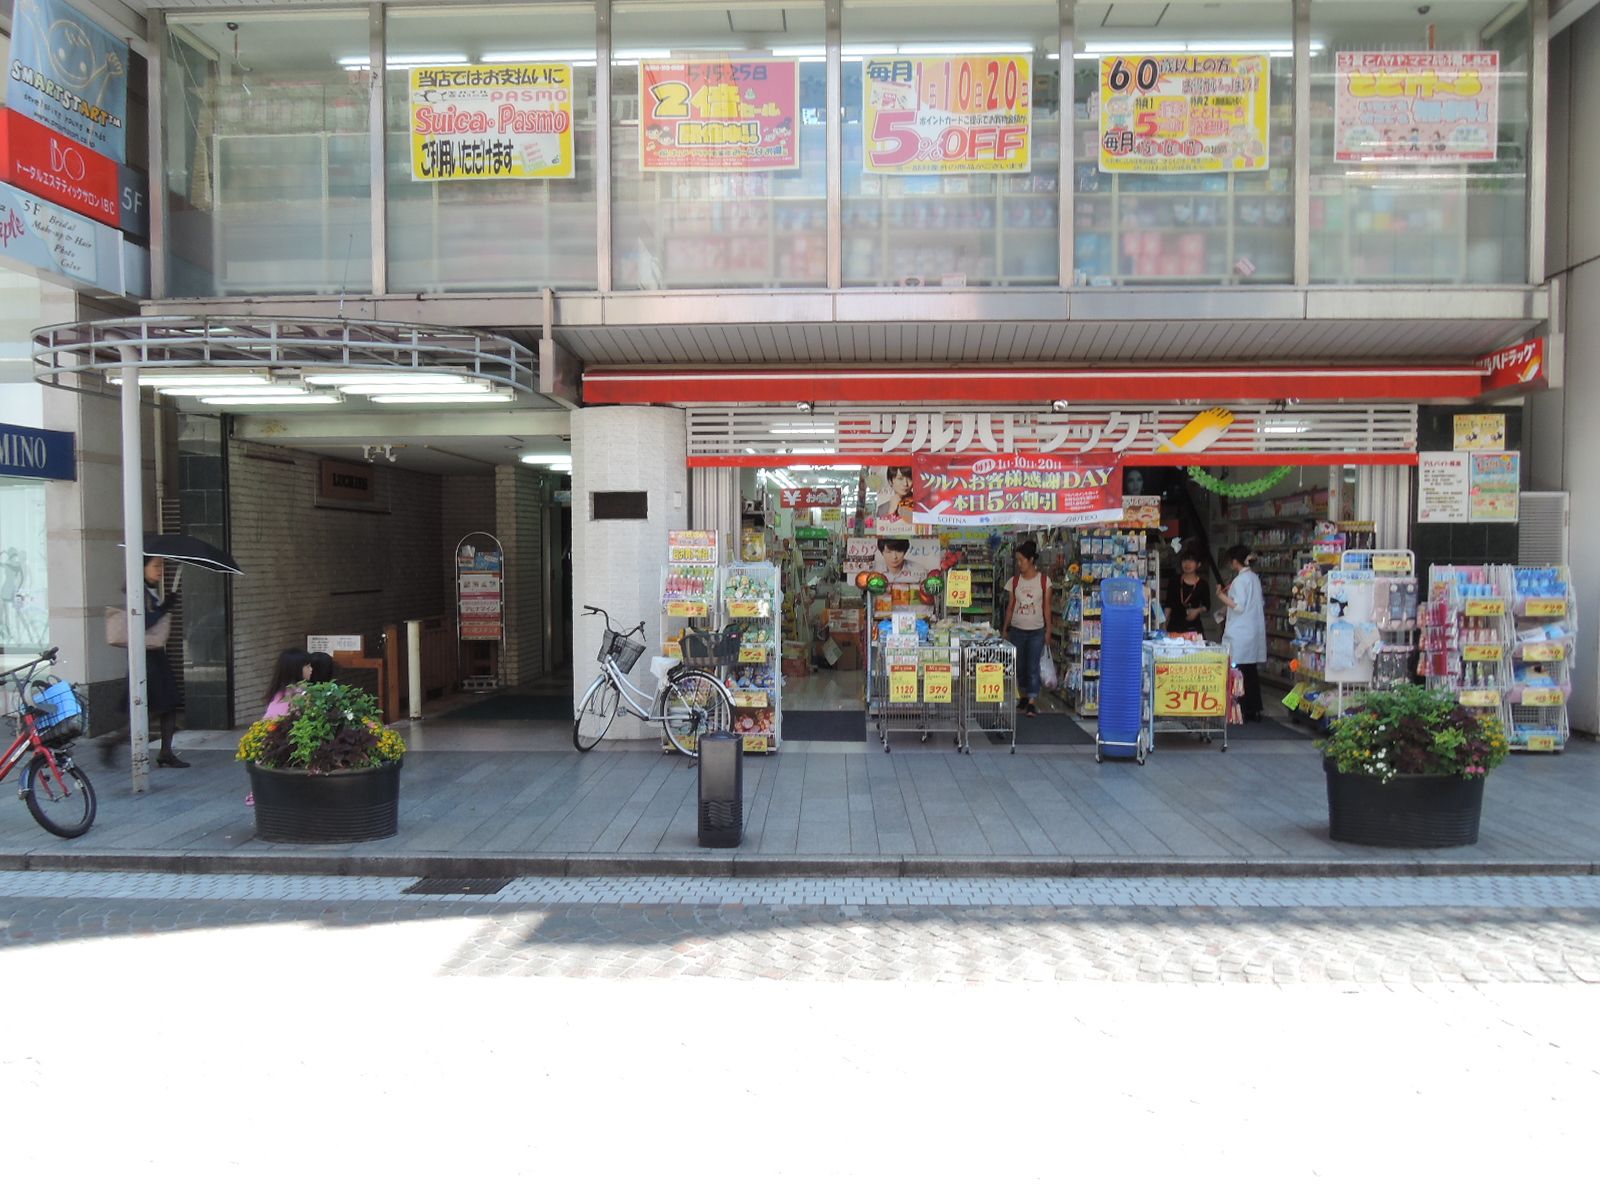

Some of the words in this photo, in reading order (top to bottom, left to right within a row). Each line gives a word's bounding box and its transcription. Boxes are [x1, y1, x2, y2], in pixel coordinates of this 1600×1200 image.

[418, 67, 565, 88] 当店ではお支払いに
[867, 61, 913, 82] 毎月
[490, 89, 568, 102] PASMO
[1103, 131, 1134, 153] 毎月
[121, 186, 144, 214] 5F
[870, 411, 1151, 454] ツルハドラッグ
[937, 516, 967, 525] SOFINA
